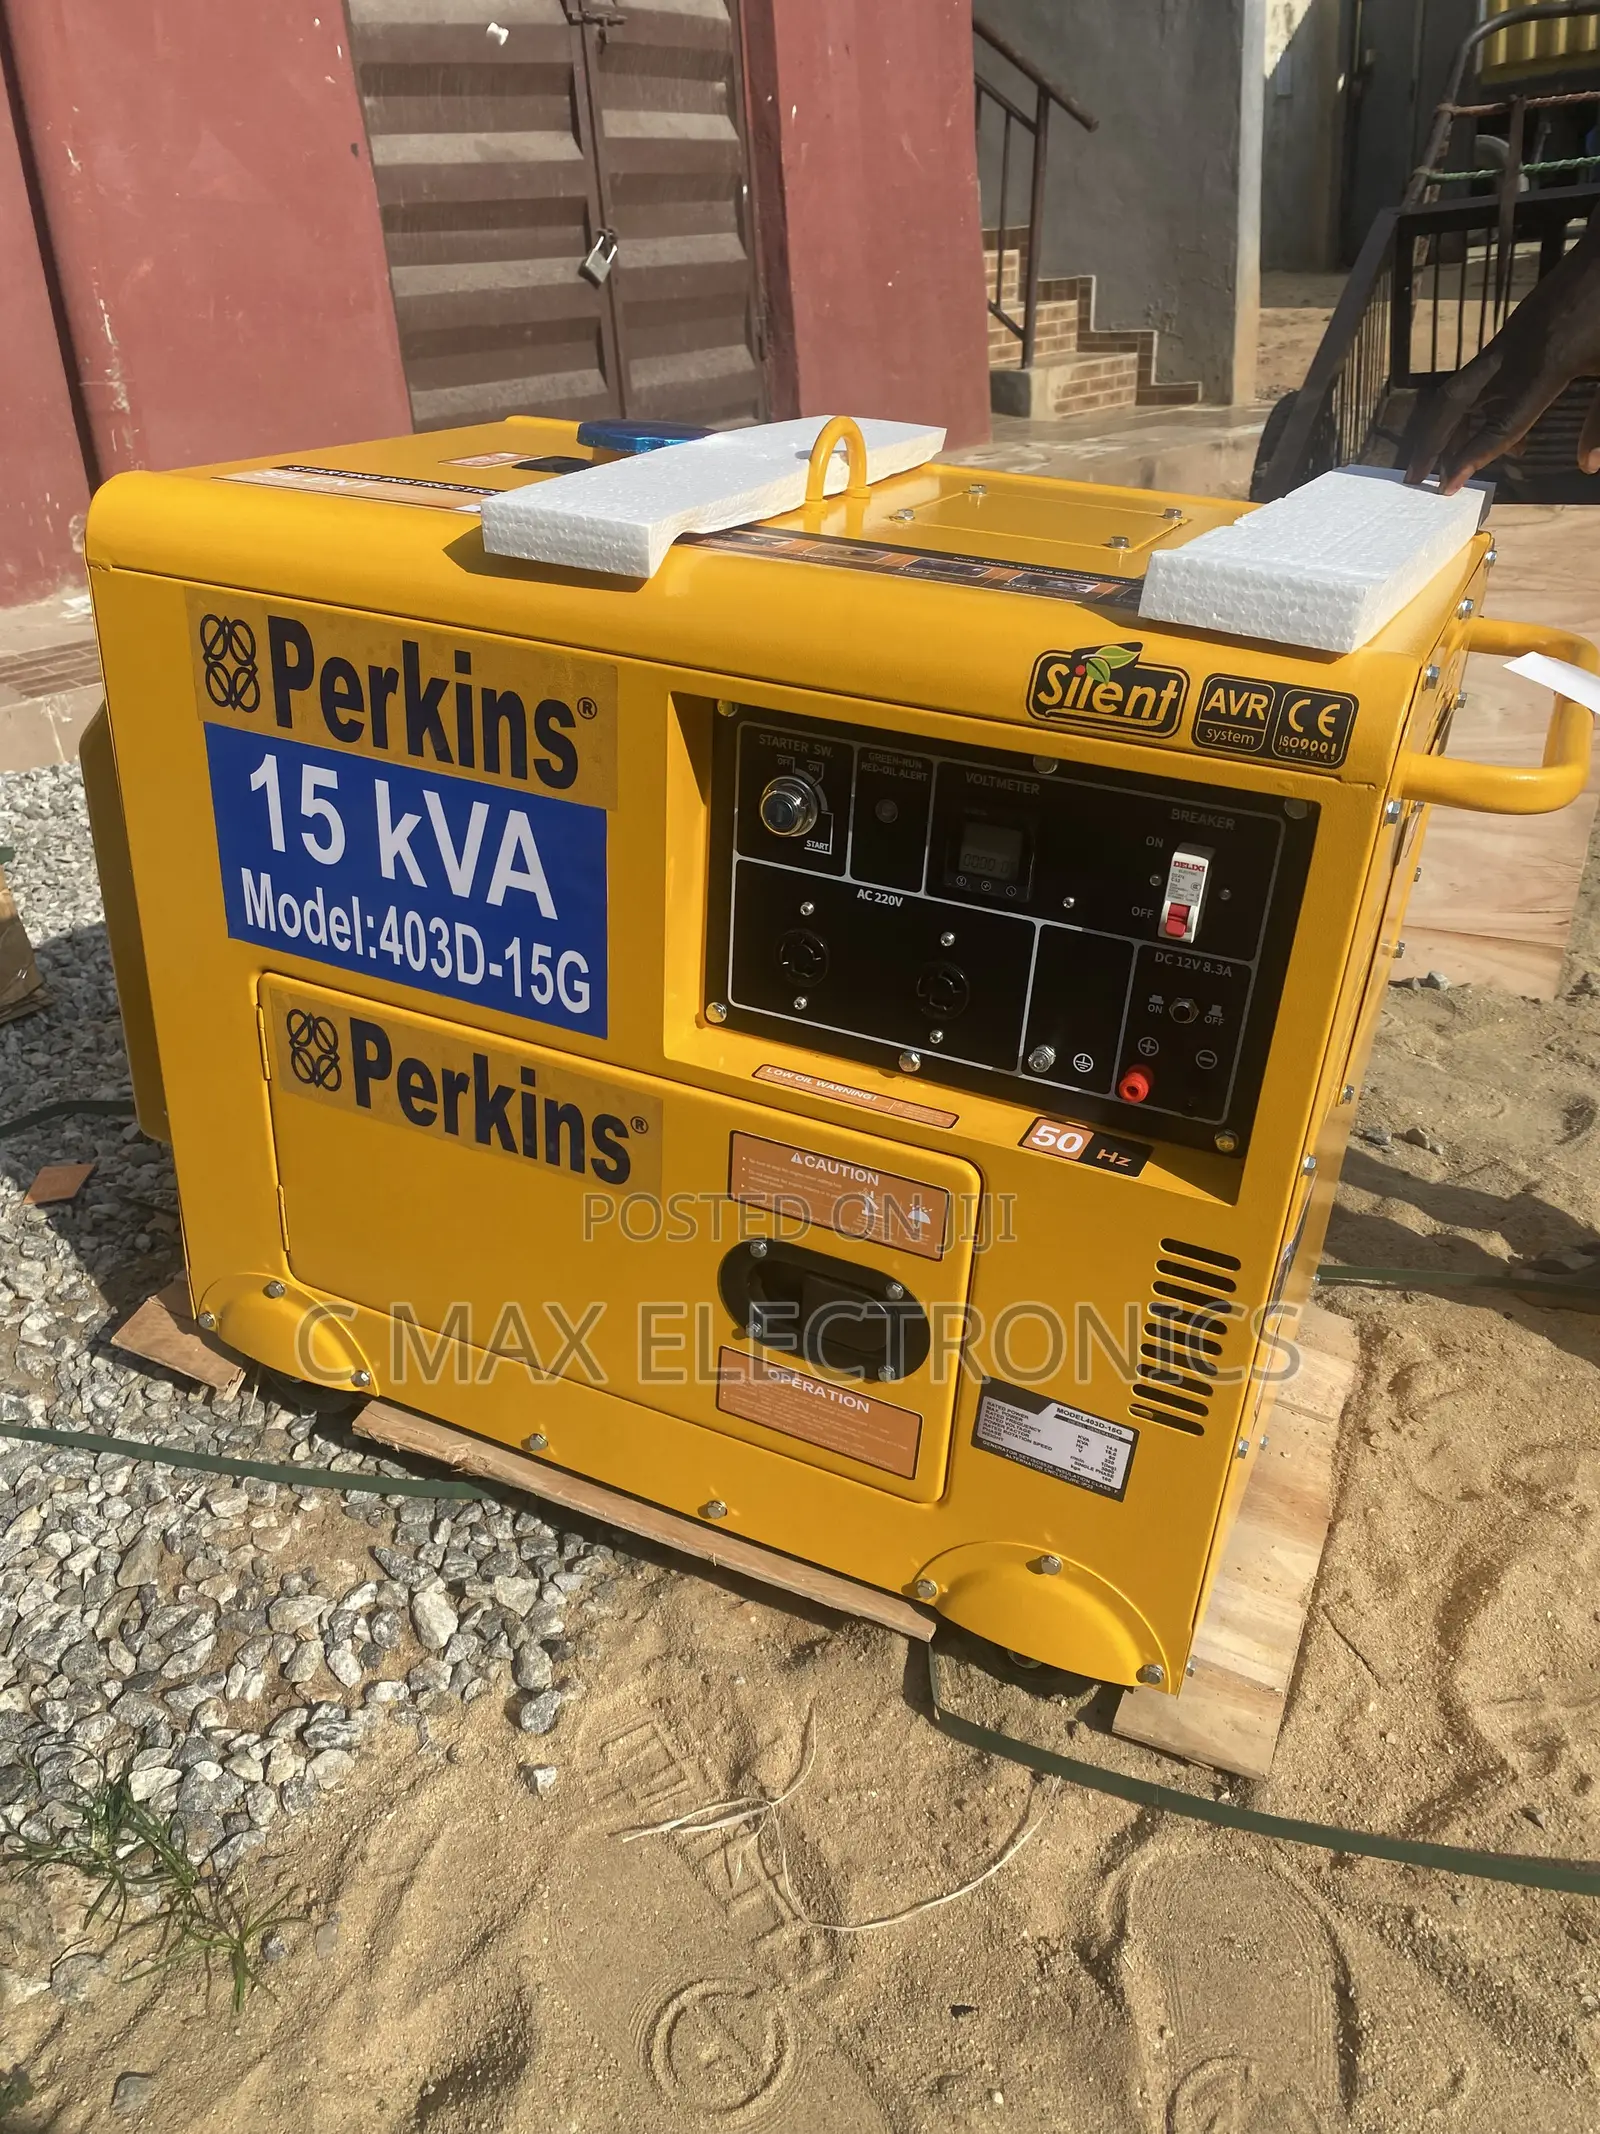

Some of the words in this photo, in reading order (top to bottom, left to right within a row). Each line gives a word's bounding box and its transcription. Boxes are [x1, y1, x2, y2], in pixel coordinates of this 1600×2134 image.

[288, 466, 381, 480] STARTING
[1037, 662, 1178, 724] Silent
[1204, 687, 1269, 721] AVR
[1288, 698, 1341, 738] CE
[758, 733, 808, 753] STARTER
[813, 744, 834, 758] SW.
[1206, 726, 1255, 747] system
[1279, 734, 1337, 756] ISO9001
[777, 757, 791, 767] OFF
[808, 763, 820, 773] ON
[861, 762, 897, 778] RED-OIL
[899, 769, 928, 782] ALERT
[868, 752, 922, 770] GREEN-RUN
[965, 771, 1040, 796] VOLTMETER
[1171, 808, 1236, 831] BREAKER
[249, 753, 346, 866] 15
[374, 778, 559, 921] kVA
[806, 839, 830, 851] START
[1146, 835, 1164, 849] ON
[1173, 860, 1205, 873] DELIXI
[857, 888, 873, 901] AC
[874, 892, 904, 907] 220V
[1131, 905, 1155, 919] OFF
[241, 867, 591, 1015] Model:403D-15G
[1154, 951, 1175, 966] DC
[1175, 955, 1200, 971] 12V
[1203, 959, 1233, 978] 8.3A
[1147, 1003, 1163, 1015] ON
[1204, 1014, 1225, 1027] OFF
[766, 1067, 793, 1079] LOW
[795, 1073, 813, 1084] OIL
[816, 1079, 877, 1102] WARNING!
[1030, 1125, 1085, 1154] 50
[1096, 1148, 1134, 1168] Hz
[804, 1153, 880, 1187] CAUTION
[767, 1368, 871, 1415] OPERATION
[983, 1418, 1006, 1429] POWER
[1006, 1426, 1030, 1438] FACTOR
[984, 1413, 1004, 1424] RATED
[1005, 1422, 1032, 1435] VOLTAGE
[985, 1409, 1005, 1420] RATED
[1005, 1417, 1042, 1433] FREQUENCY
[987, 1401, 1006, 1411] RATED
[1007, 1408, 1029, 1420] POWER
[1077, 1434, 1090, 1443] KVA
[1001, 1411, 1023, 1422] POWER
[1076, 1439, 1089, 1447] KVA
[981, 1430, 1004, 1442] WEIGHT
[982, 1422, 1002, 1432] RATED
[1003, 1429, 1032, 1444] ROTATION
[1033, 1440, 1053, 1452] SPEED
[982, 1426, 1002, 1437] PHASE
[1073, 1460, 1095, 1473] SINGLE
[1095, 1468, 1115, 1479] PHASE
[982, 1440, 1018, 1456] GENERATOR
[1055, 1467, 1090, 1484] INSULATION
[1005, 1453, 1043, 1471] ALTERNATOR
